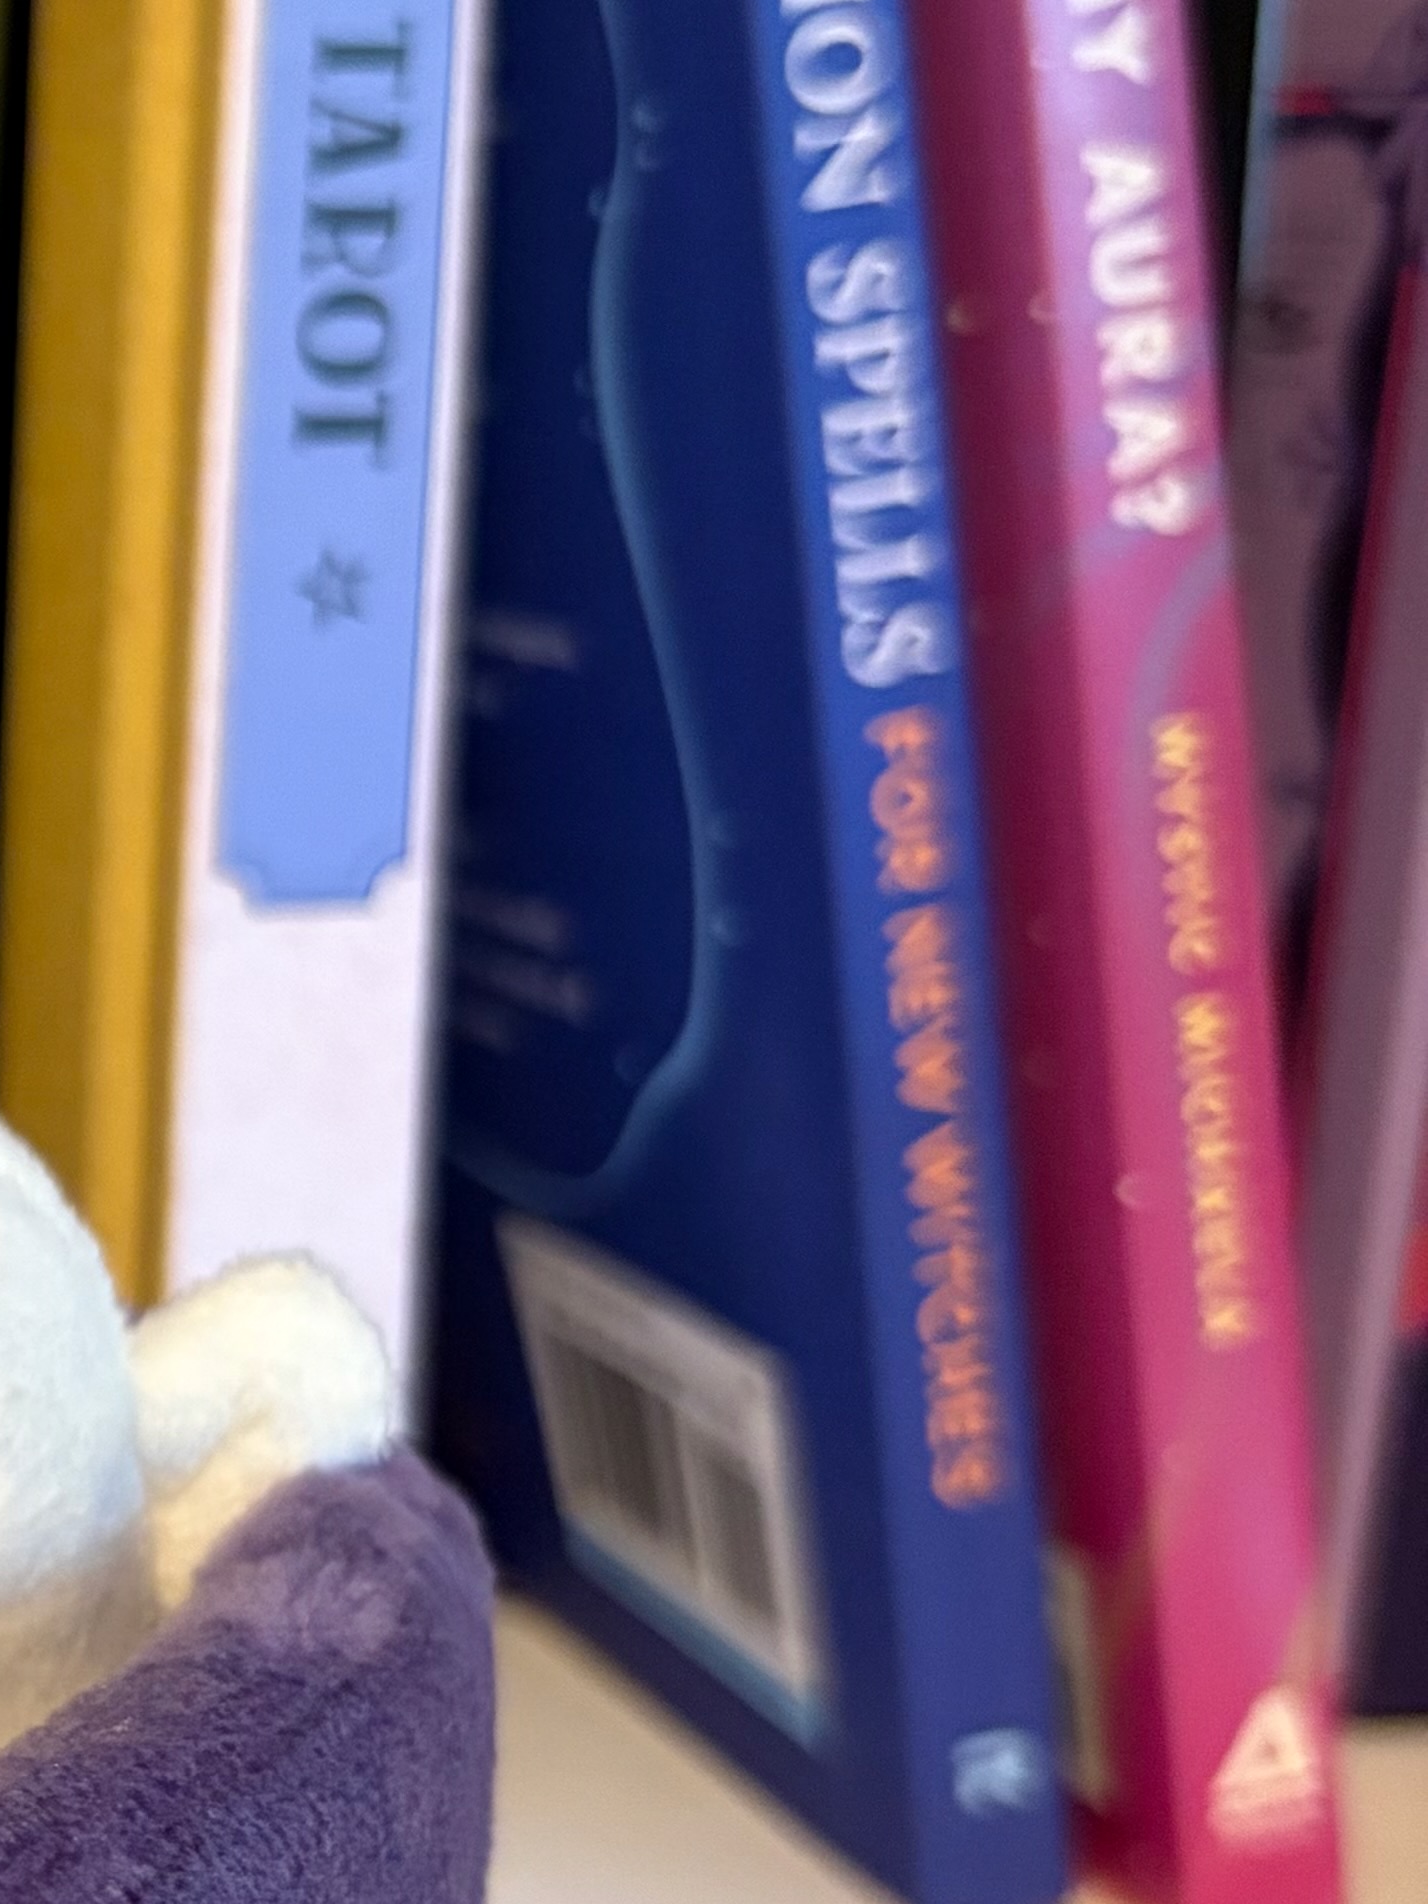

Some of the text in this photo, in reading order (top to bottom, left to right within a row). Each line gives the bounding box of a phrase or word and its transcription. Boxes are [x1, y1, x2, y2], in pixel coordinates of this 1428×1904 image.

[291, 18, 410, 465] TAROT
[1078, 141, 1202, 536] AURA?
[805, 236, 952, 690] SPELLS
[864, 705, 948, 893] FOR
[882, 902, 969, 1113] NEW
[901, 1116, 1004, 1505] WITCHES
